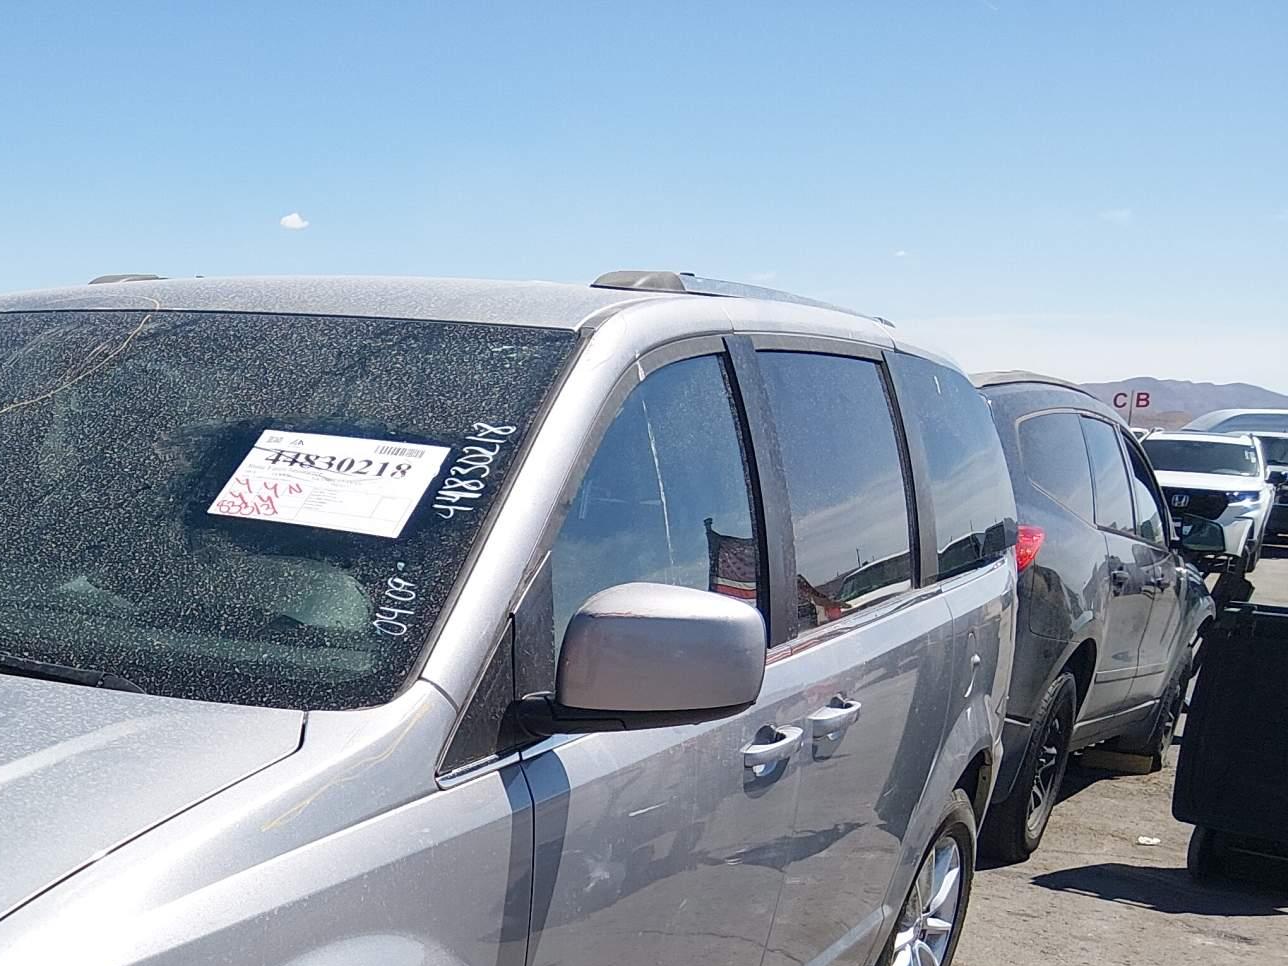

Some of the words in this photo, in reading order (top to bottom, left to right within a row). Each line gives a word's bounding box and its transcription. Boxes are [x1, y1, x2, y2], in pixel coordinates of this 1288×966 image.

[1113, 392, 1128, 408] C
[1135, 392, 1150, 408] B
[265, 449, 413, 479] 44830218
[431, 422, 517, 519] 44830218
